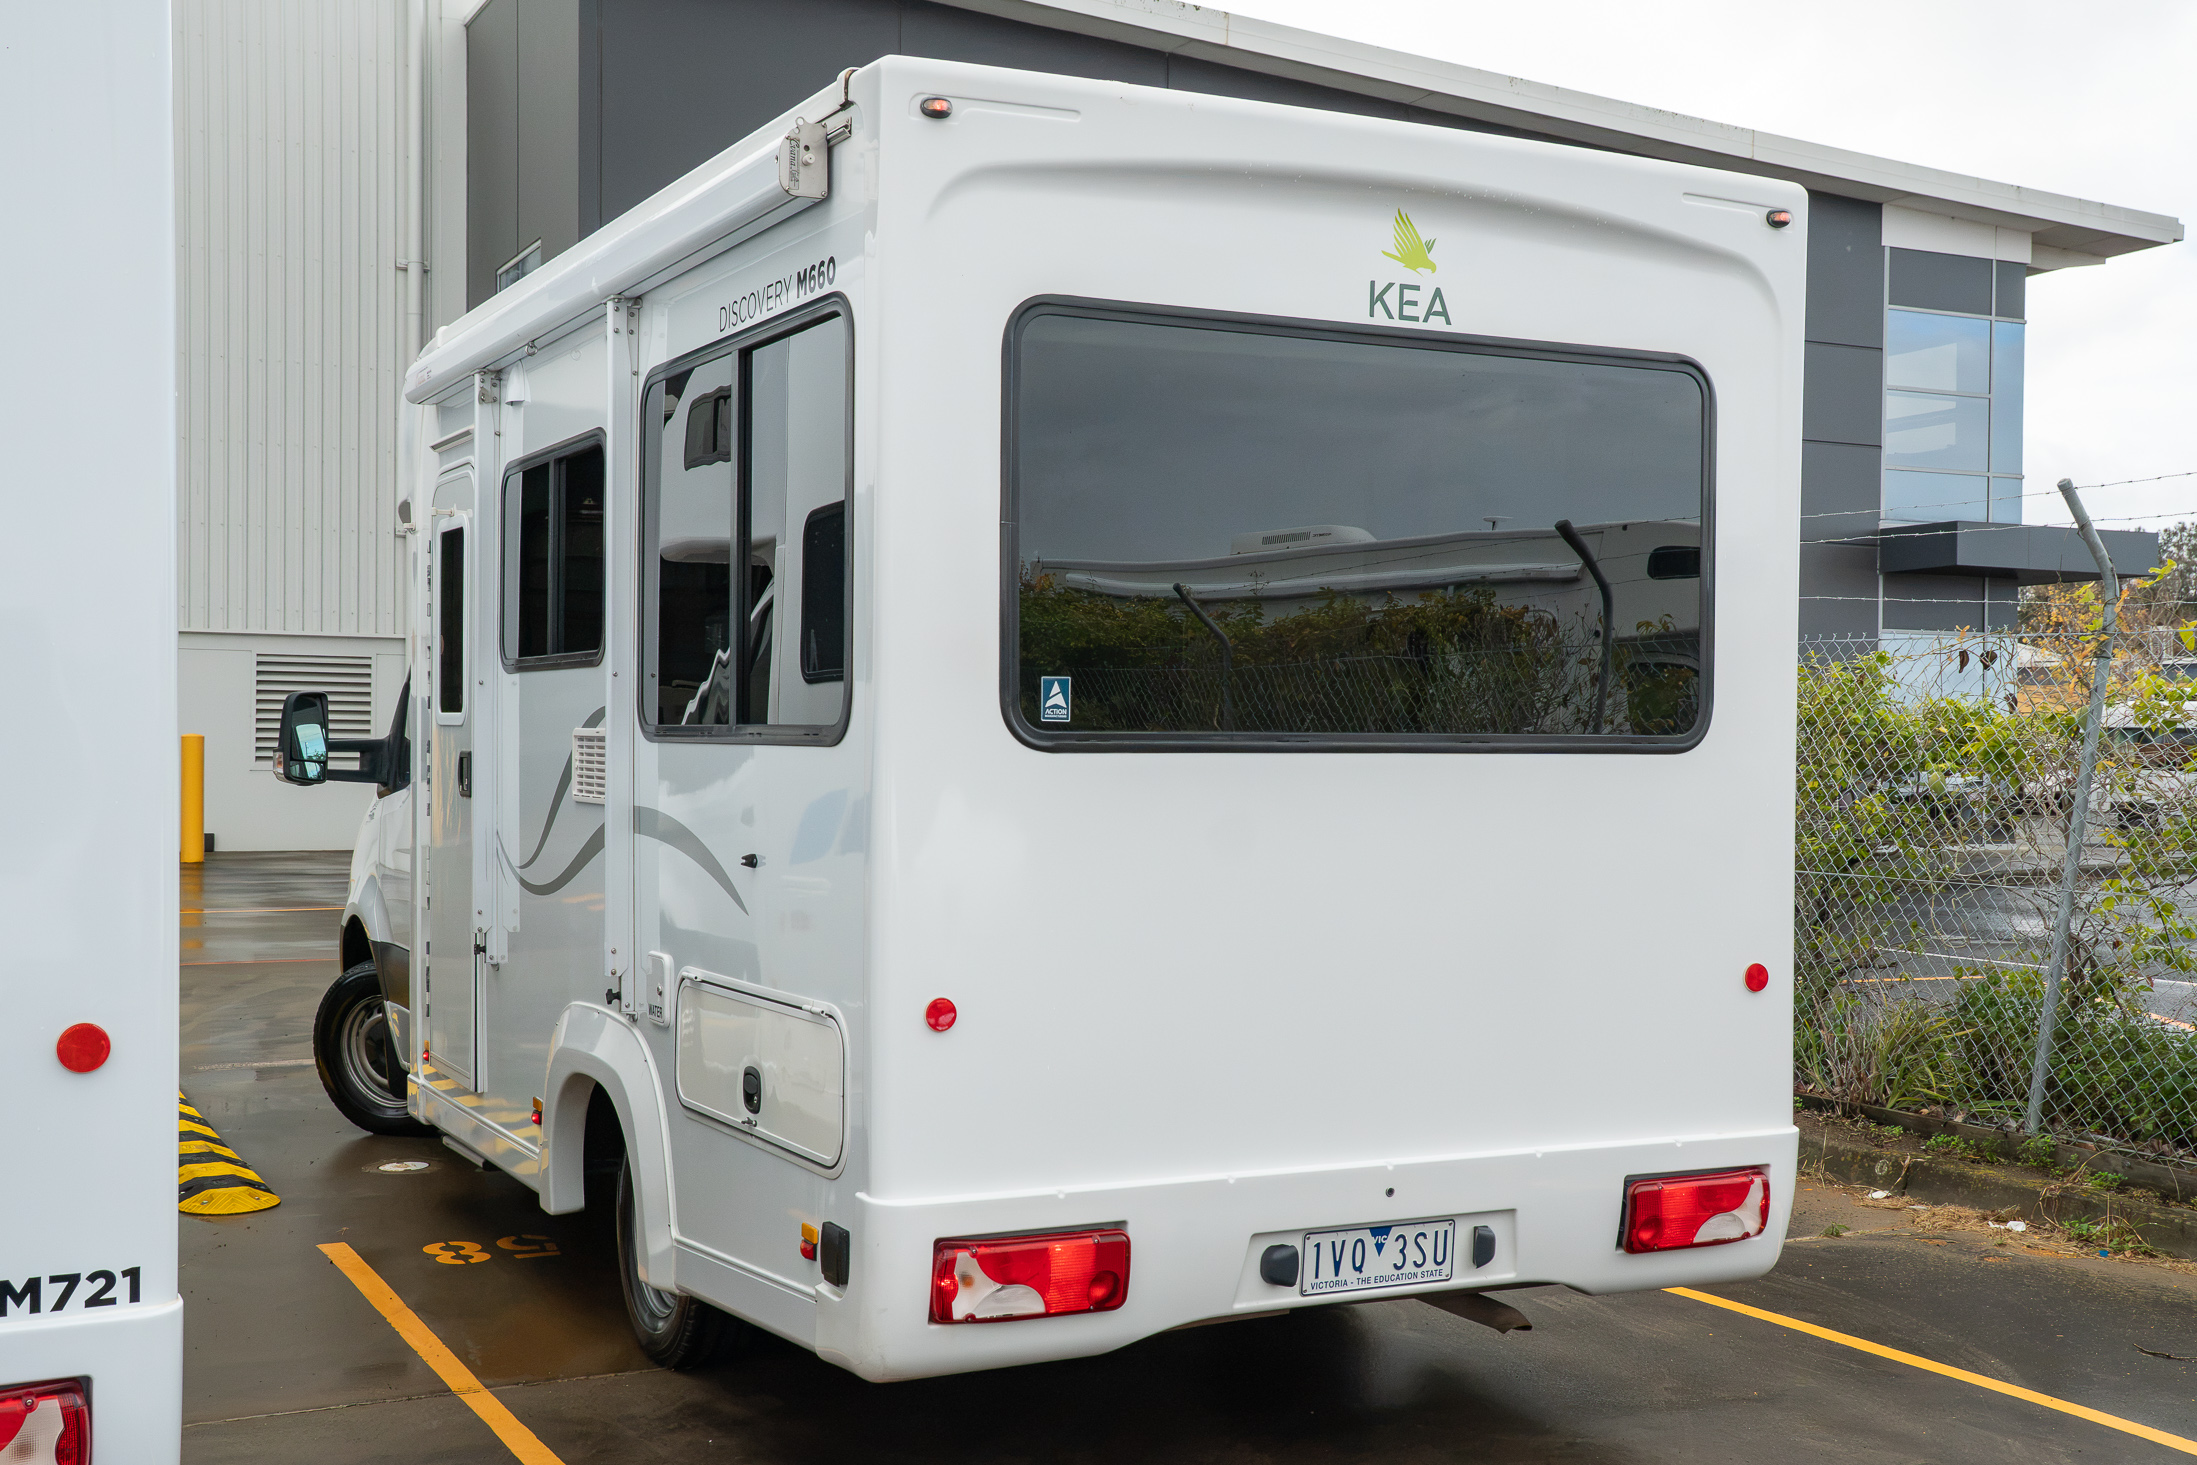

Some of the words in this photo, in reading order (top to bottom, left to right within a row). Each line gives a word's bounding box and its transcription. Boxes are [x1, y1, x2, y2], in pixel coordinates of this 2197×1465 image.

[719, 275, 792, 333] DISCOVERY
[796, 256, 836, 299] M660
[1369, 280, 1452, 325] KEA
[648, 1003, 663, 1019] WATER
[1313, 1238, 1365, 1279] 1VQ
[1393, 1229, 1448, 1271] 3SU
[0, 1266, 141, 1318] M721
[1310, 1279, 1348, 1290] VICTORIA
[1356, 1276, 1372, 1286] THE
[1374, 1271, 1418, 1284] EDUCATION
[1420, 1268, 1443, 1279] STATE
